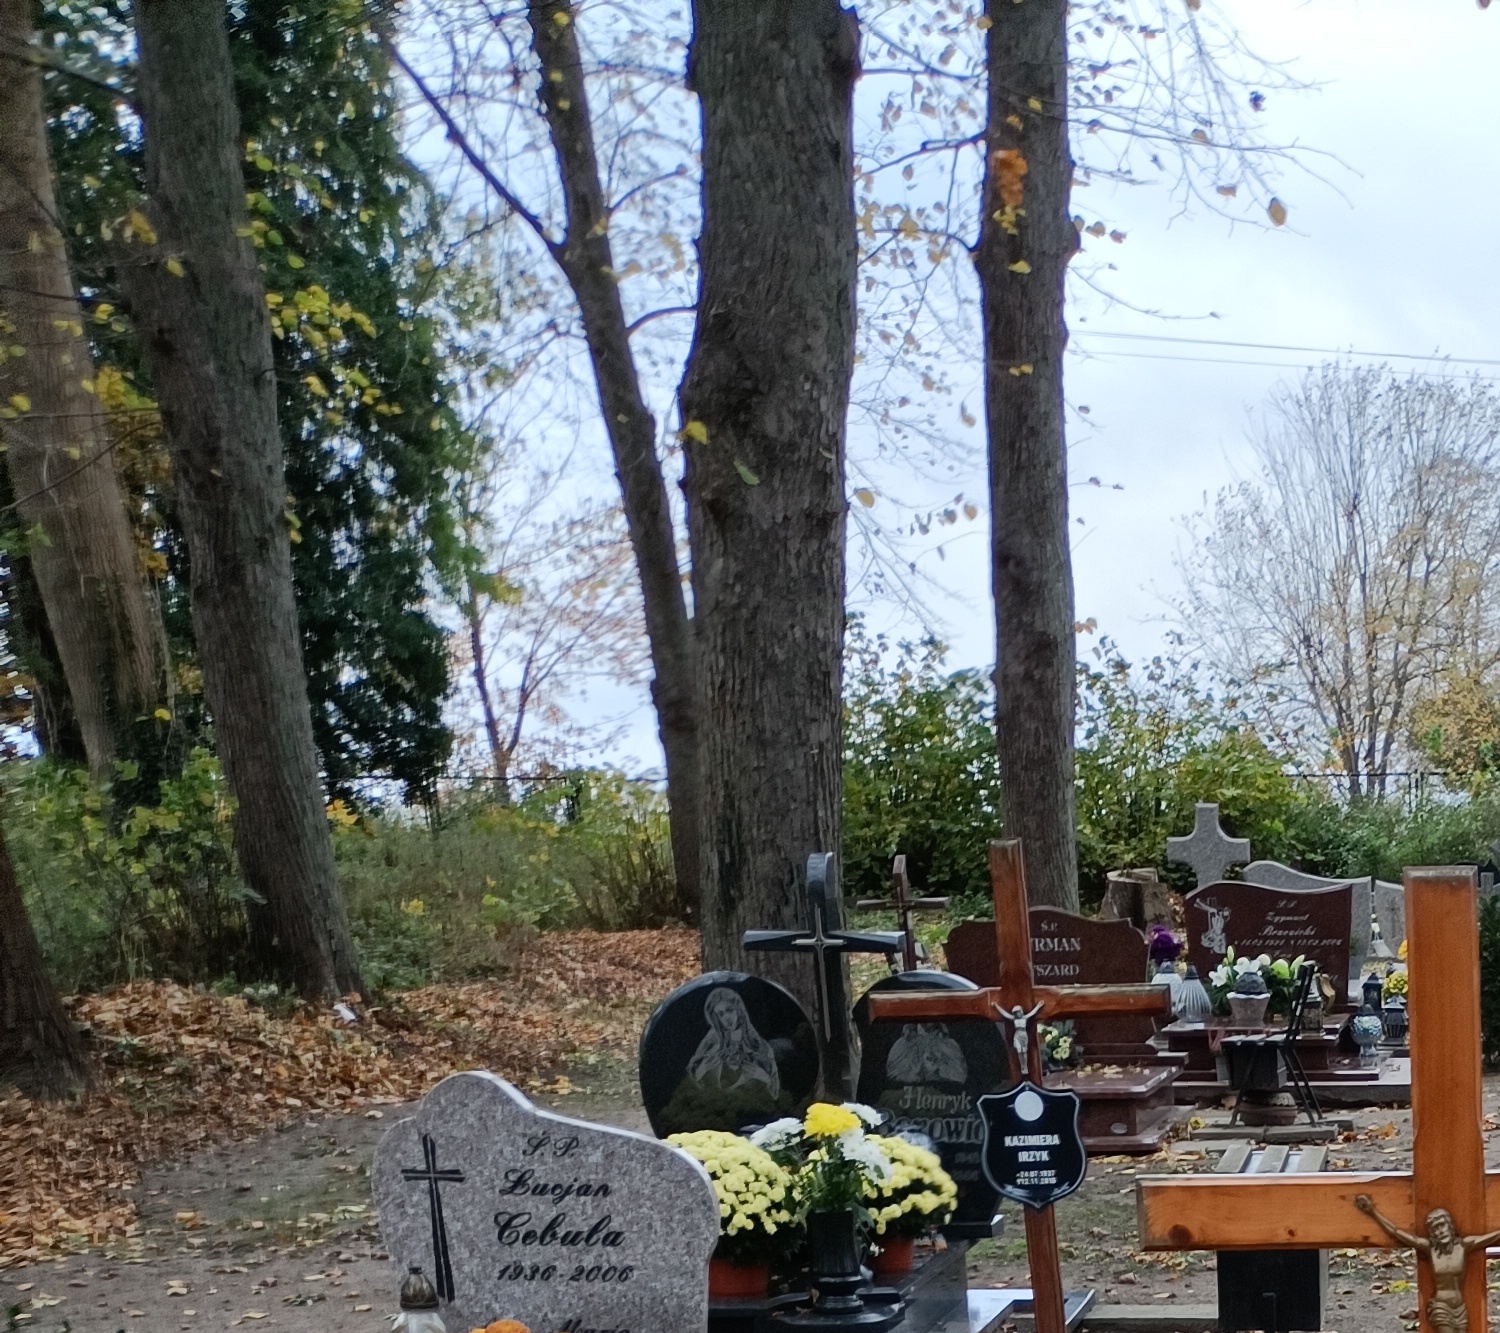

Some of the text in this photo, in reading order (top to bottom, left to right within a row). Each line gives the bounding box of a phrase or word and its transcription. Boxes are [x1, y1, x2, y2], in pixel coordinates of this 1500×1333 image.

[898, 1085, 972, 1115] Henryk
[1004, 1133, 1062, 1148] KAZIMIERA
[1018, 1150, 1051, 1163] IRZYK
[499, 1168, 613, 1205] Lucjan
[493, 1211, 627, 1247] Cebula
